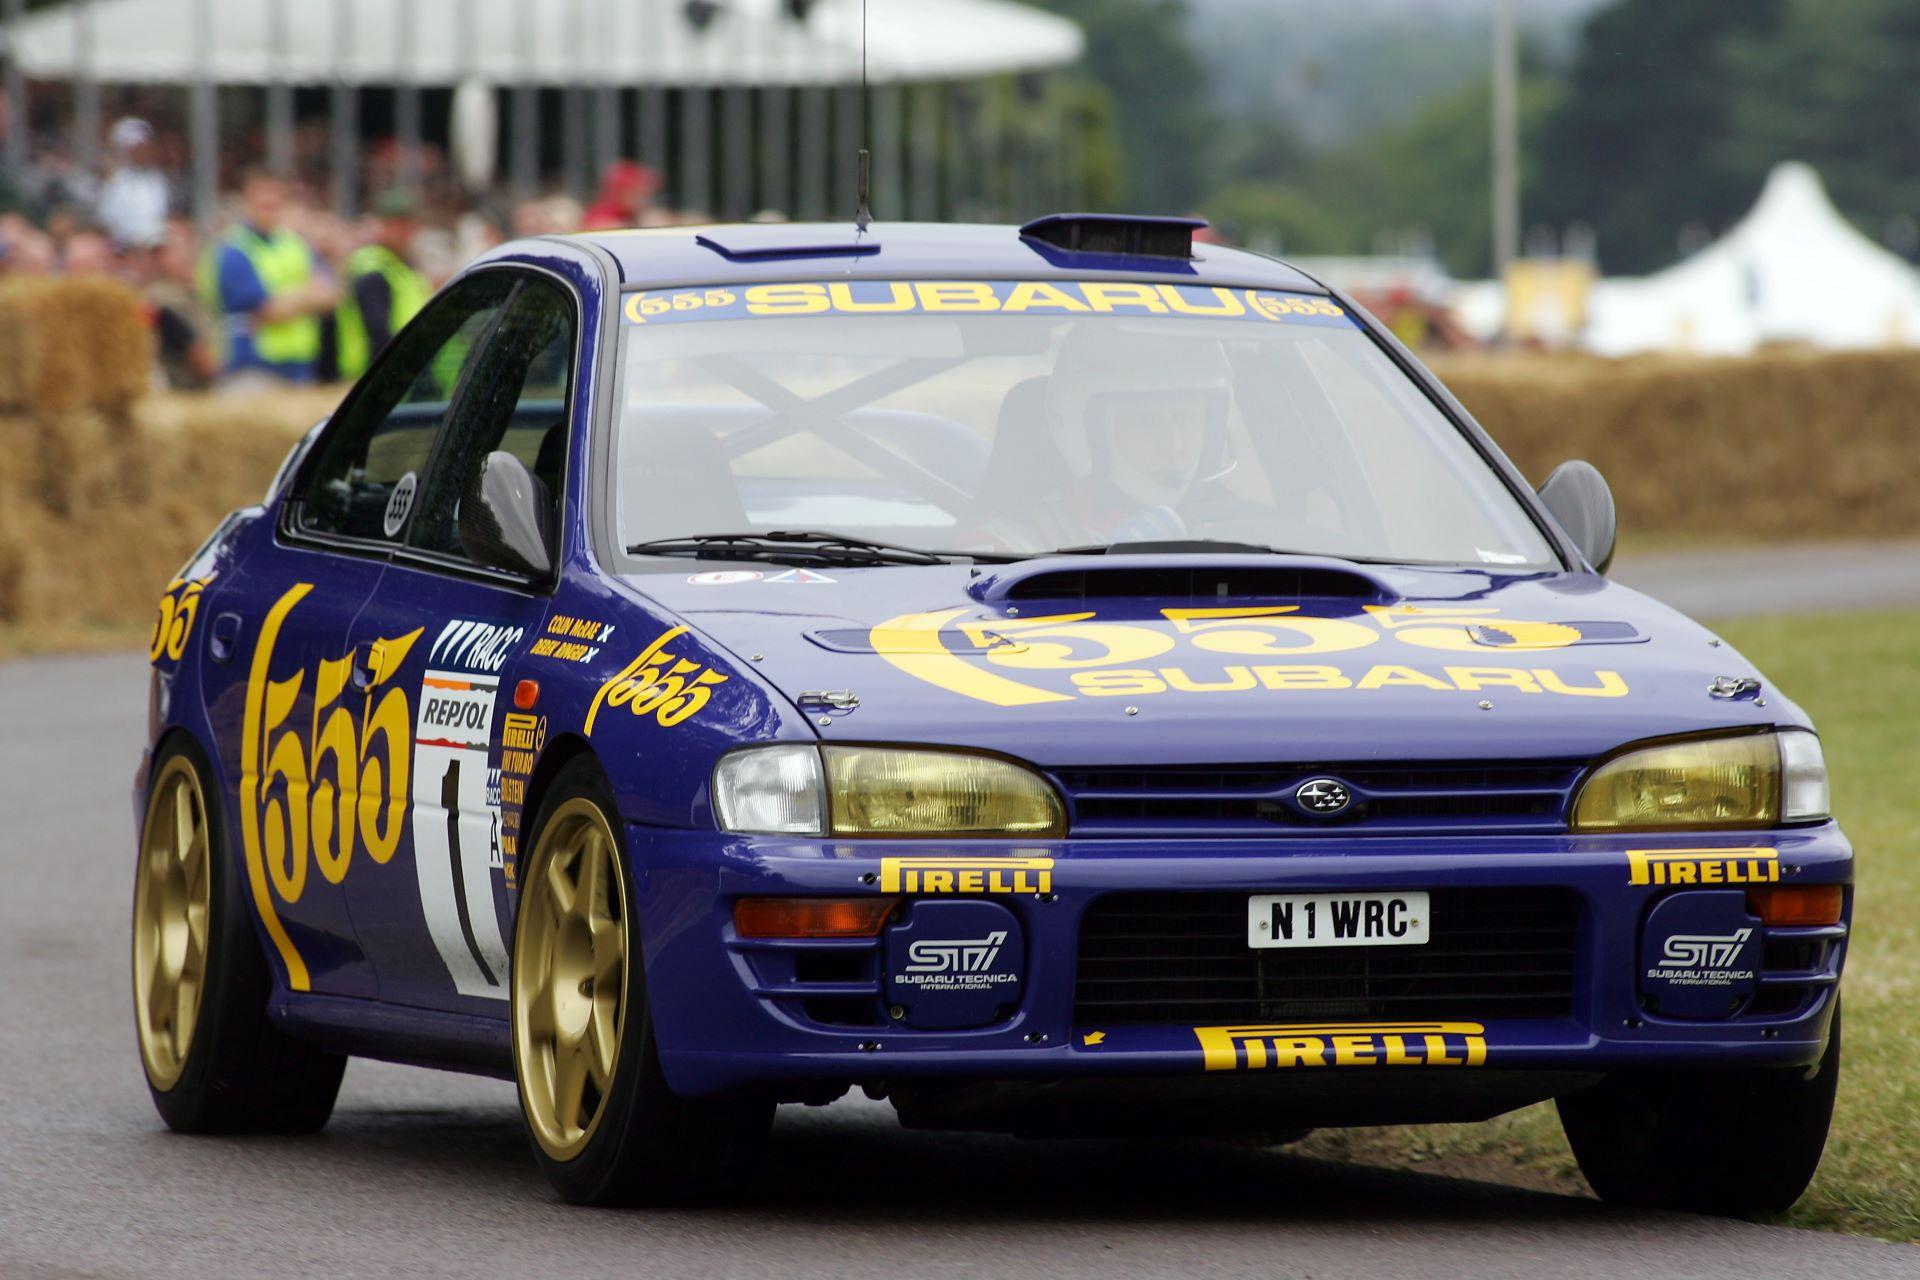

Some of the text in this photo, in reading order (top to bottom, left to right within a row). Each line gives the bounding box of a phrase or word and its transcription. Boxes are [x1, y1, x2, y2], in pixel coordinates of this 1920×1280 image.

[640, 281, 1344, 317] 555 SUBARU 555
[547, 615, 574, 635] COLIN
[1070, 664, 1629, 698] SUBARU
[423, 698, 489, 730] REPSOL
[502, 712, 538, 750] PIRELLI
[440, 759, 500, 986] 1
[880, 857, 1055, 893] PIRELLI
[1625, 847, 1780, 885] PIRELLI
[1271, 898, 1408, 940] N 1 WRC
[895, 973, 1018, 984] SUBARU TECNICA
[1647, 970, 1754, 979] SUBARU TECNICA
[1193, 1022, 1488, 1071] PIRELLI
